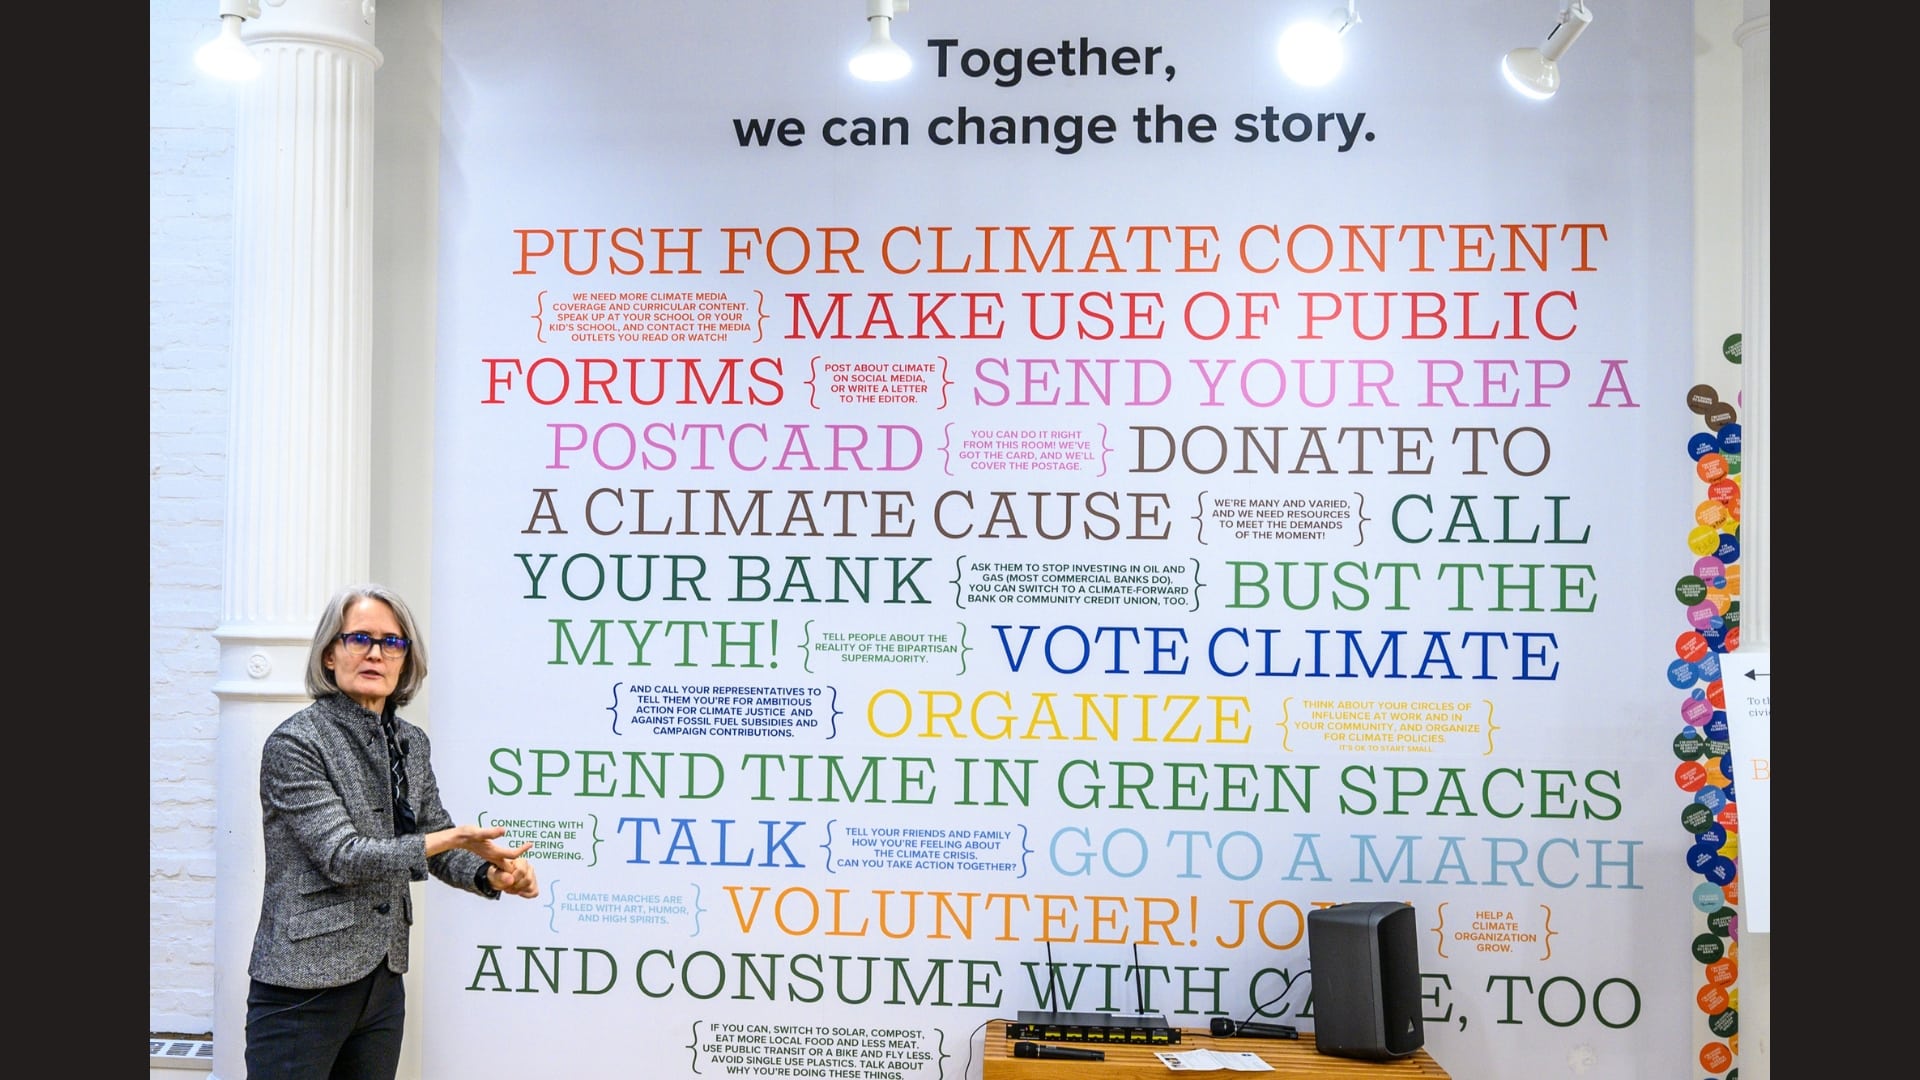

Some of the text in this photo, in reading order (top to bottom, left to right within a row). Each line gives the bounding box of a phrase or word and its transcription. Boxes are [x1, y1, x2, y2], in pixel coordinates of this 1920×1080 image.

[928, 37, 1176, 87] Together,
[733, 104, 1375, 155] we can change the story.
[513, 224, 1608, 276] PUSH FOR CLIMATE CONTENT
[573, 293, 727, 301] WE NEED MORE CLIMATE MEDIA
[553, 303, 748, 311] COVERAGE AND CURRICULAR CONTENT.
[784, 291, 1577, 341] MAKE USE OF PUBLIC
[825, 364, 935, 372] POST ABOUT CLIMATE
[481, 357, 784, 406] FORUMS
[833, 374, 925, 383] ON SOCIAL MEDIA,
[974, 358, 1640, 408] SEND YOUR REP A
[848, 385, 879, 393] WRITE
[881, 385, 889, 393] A
[892, 385, 928, 393] LETTER
[840, 395, 917, 403] TO THE EDITOR.
[546, 423, 923, 471] POSTCARD
[1129, 425, 1551, 477] DONATE TO
[1215, 499, 1350, 509] WE'RE MANY AND VARIED,
[521, 488, 1171, 541] A CLIMATE CAUSE
[1212, 509, 1350, 519] AND WE NEED RESOURCES
[1392, 494, 1591, 544] CALL
[1220, 520, 1343, 530] TO MEET THE DEMANDS
[1235, 531, 1325, 540] OF THE MOMENT!
[971, 563, 1185, 573] ASK THEM TO STOP INVESTING IN OIL AND
[513, 553, 932, 604] YOUR BANK
[983, 574, 1173, 585] GAS (MOST COMMERCIAL BANKS DO).
[1225, 561, 1597, 613] BUST THE
[823, 633, 947, 642] TELL PEOPLE ABOUT THE
[548, 619, 778, 669] MYTH!
[815, 643, 958, 653] REALITY OF THE BIPARTISAN
[842, 654, 928, 663] SUPERMAJORITY.
[991, 625, 1559, 681] VOTE CLIMATE
[1748, 697, 1760, 705] To
[631, 716, 818, 727] AGAINST FOSSIL FUEL SUBSIDIES AND
[867, 689, 1252, 744] ORGANIZE
[653, 726, 794, 737] CAMPAIGN CONTRIBUTIONS.
[488, 748, 724, 799] SPEND
[741, 754, 936, 804] TIME
[954, 758, 1039, 807] IN
[1058, 759, 1320, 813] GREEN
[1339, 765, 1622, 821] SPACES
[491, 819, 583, 829] CONNECTING WITH
[504, 831, 576, 839] ATURE CAN BE
[508, 840, 564, 850] CEERING
[617, 817, 806, 868] TALK
[852, 838, 1001, 850] HOW YOU'RE FEELING ABOUT
[517, 851, 585, 861] MPOWERING.
[874, 849, 978, 860] THE CLIMATE CRISIS.
[1050, 826, 1644, 890] GO TO A MARCH
[723, 886, 1198, 946] VOLUNTEER!
[1476, 911, 1513, 920] HELP A
[1472, 922, 1518, 931] CLIMATE
[1454, 932, 1537, 942] ORGANIZATION
[1477, 943, 1512, 952] GROW.
[465, 945, 1641, 1031] AND CONSUME WITH CE, TOO
[711, 1023, 925, 1040] IF YOU CAN, SWITCH TO SOLAR, COMPOST,
[727, 1066, 904, 1080] WHY YOU'RE DOING THESE THINGS.
